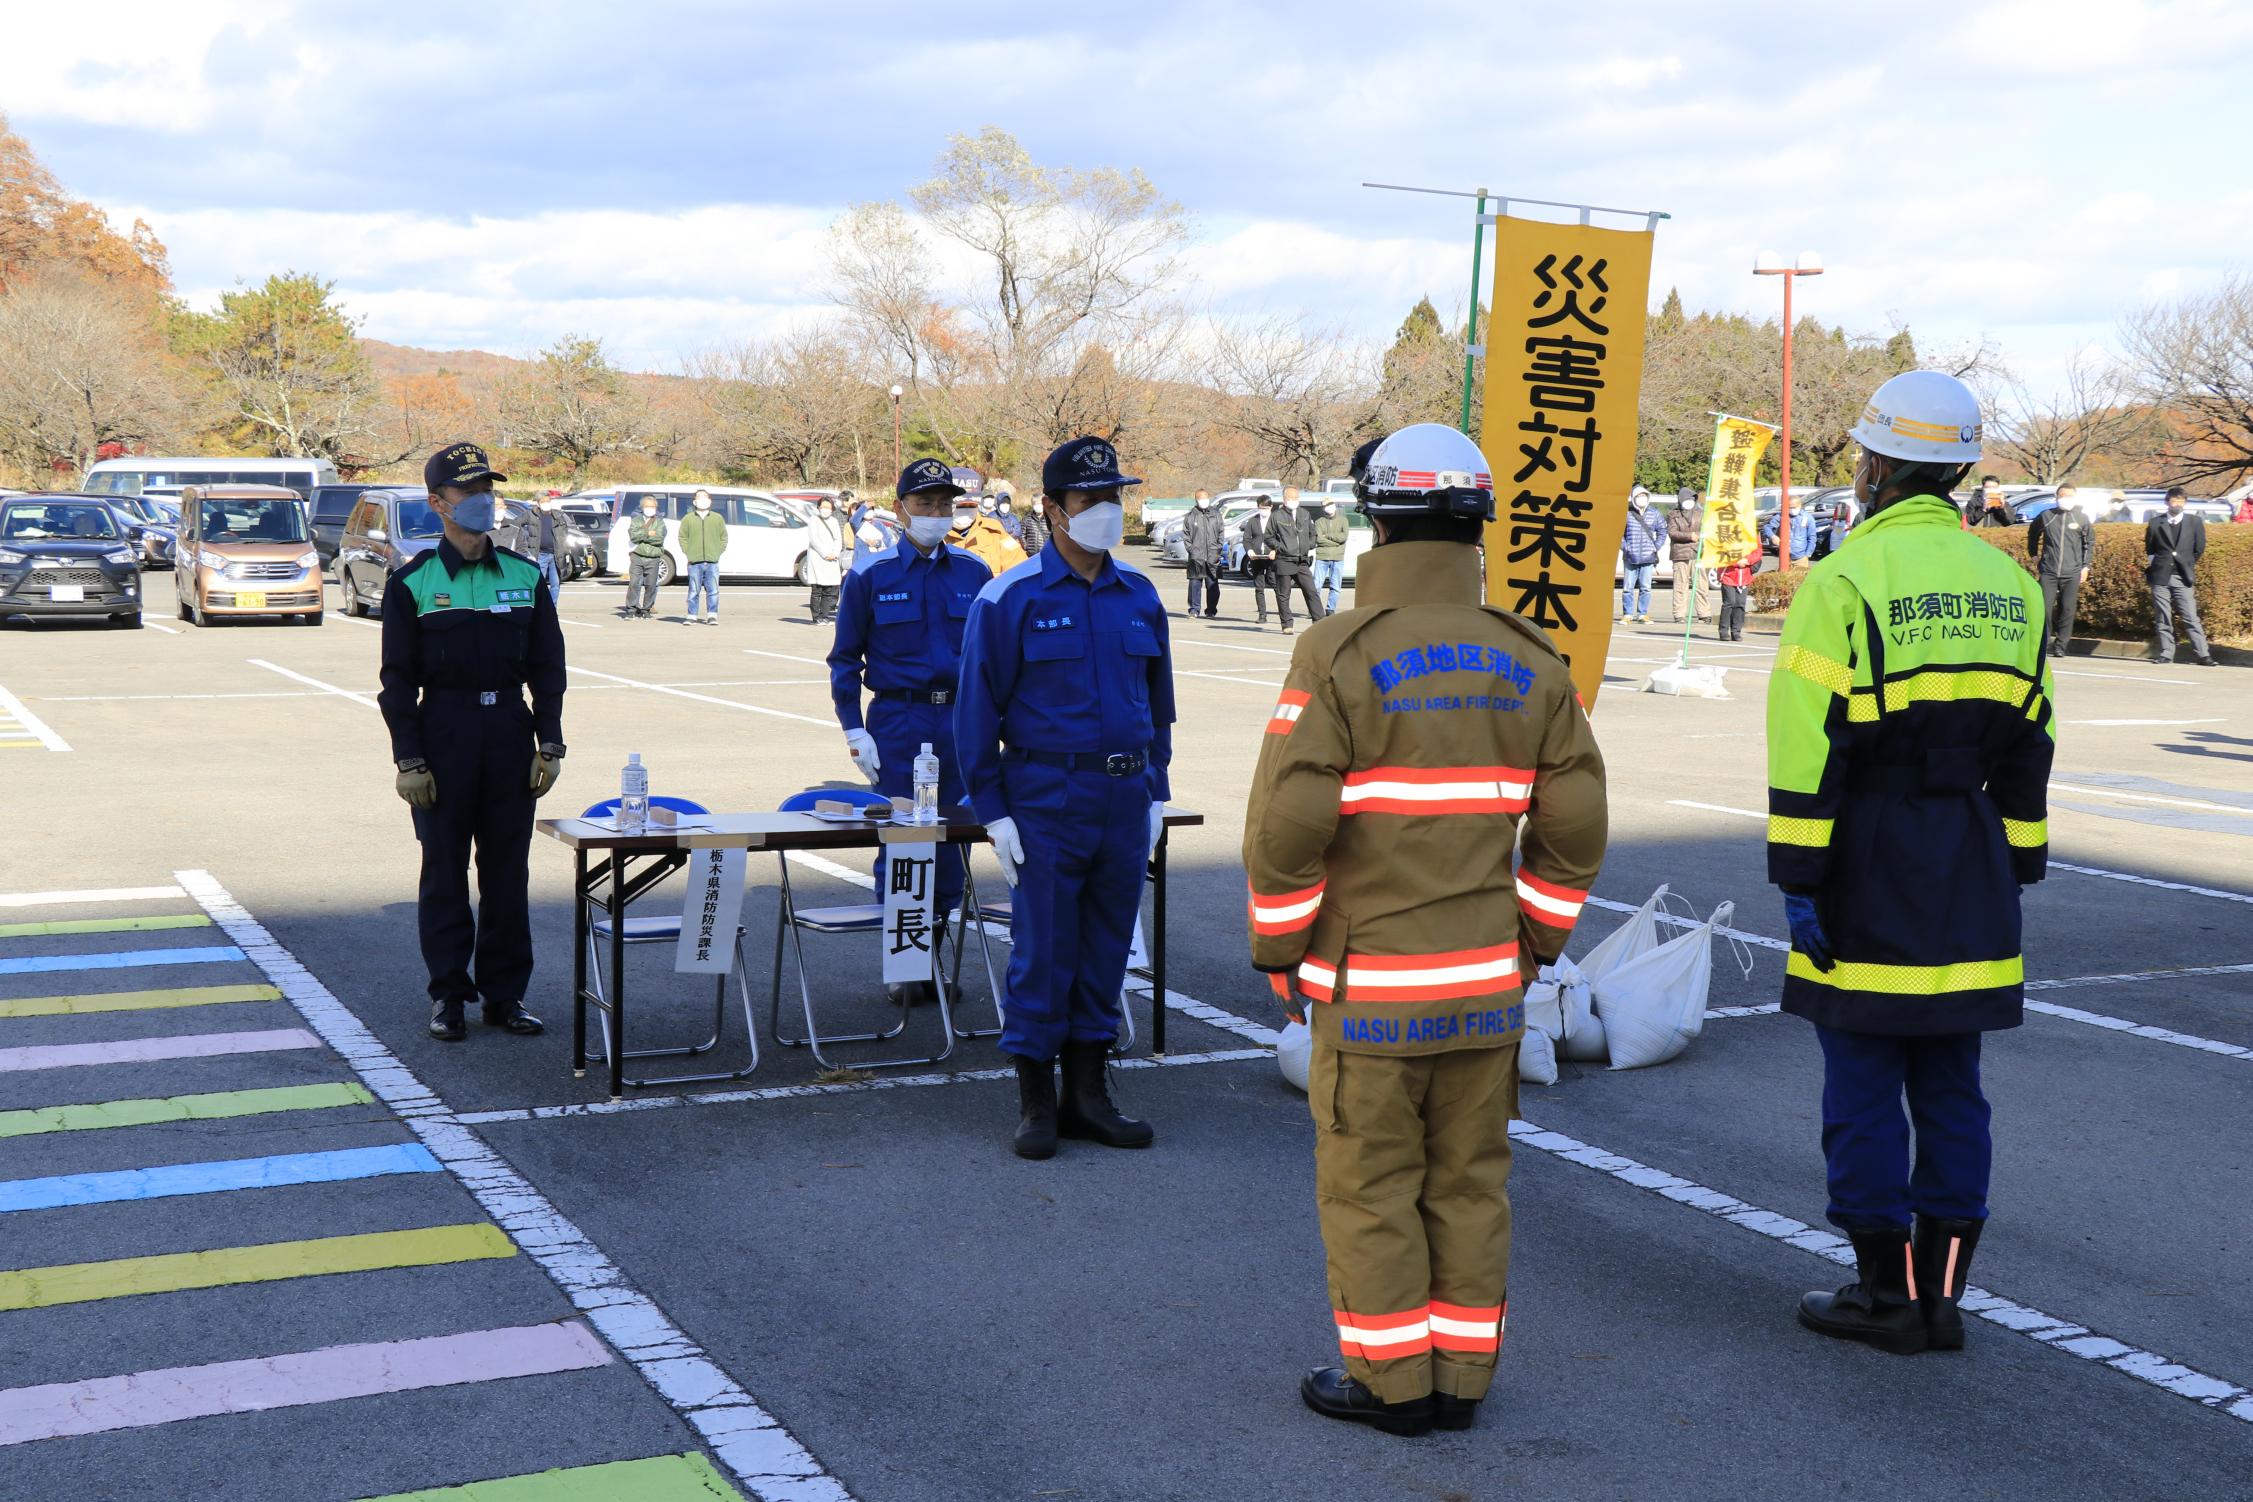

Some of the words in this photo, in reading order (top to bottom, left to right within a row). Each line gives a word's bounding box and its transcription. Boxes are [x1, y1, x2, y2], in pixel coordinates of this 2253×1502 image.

[1506, 253, 1610, 668] 災害対策本
[952, 478, 979, 488] NASU
[1889, 591, 2027, 627] 那須町消防団
[1942, 624, 1982, 639] NASU
[1369, 642, 1536, 696] 那須地区消防
[1382, 697, 1421, 714] NASU
[1425, 696, 1461, 711] AREA
[696, 848, 725, 961] 栃木県消防防災課長
[887, 856, 934, 955] 町長
[1343, 1017, 1399, 1043] NASU
[1406, 1015, 1459, 1041] AREA
[1465, 1009, 1505, 1036] FIRE
